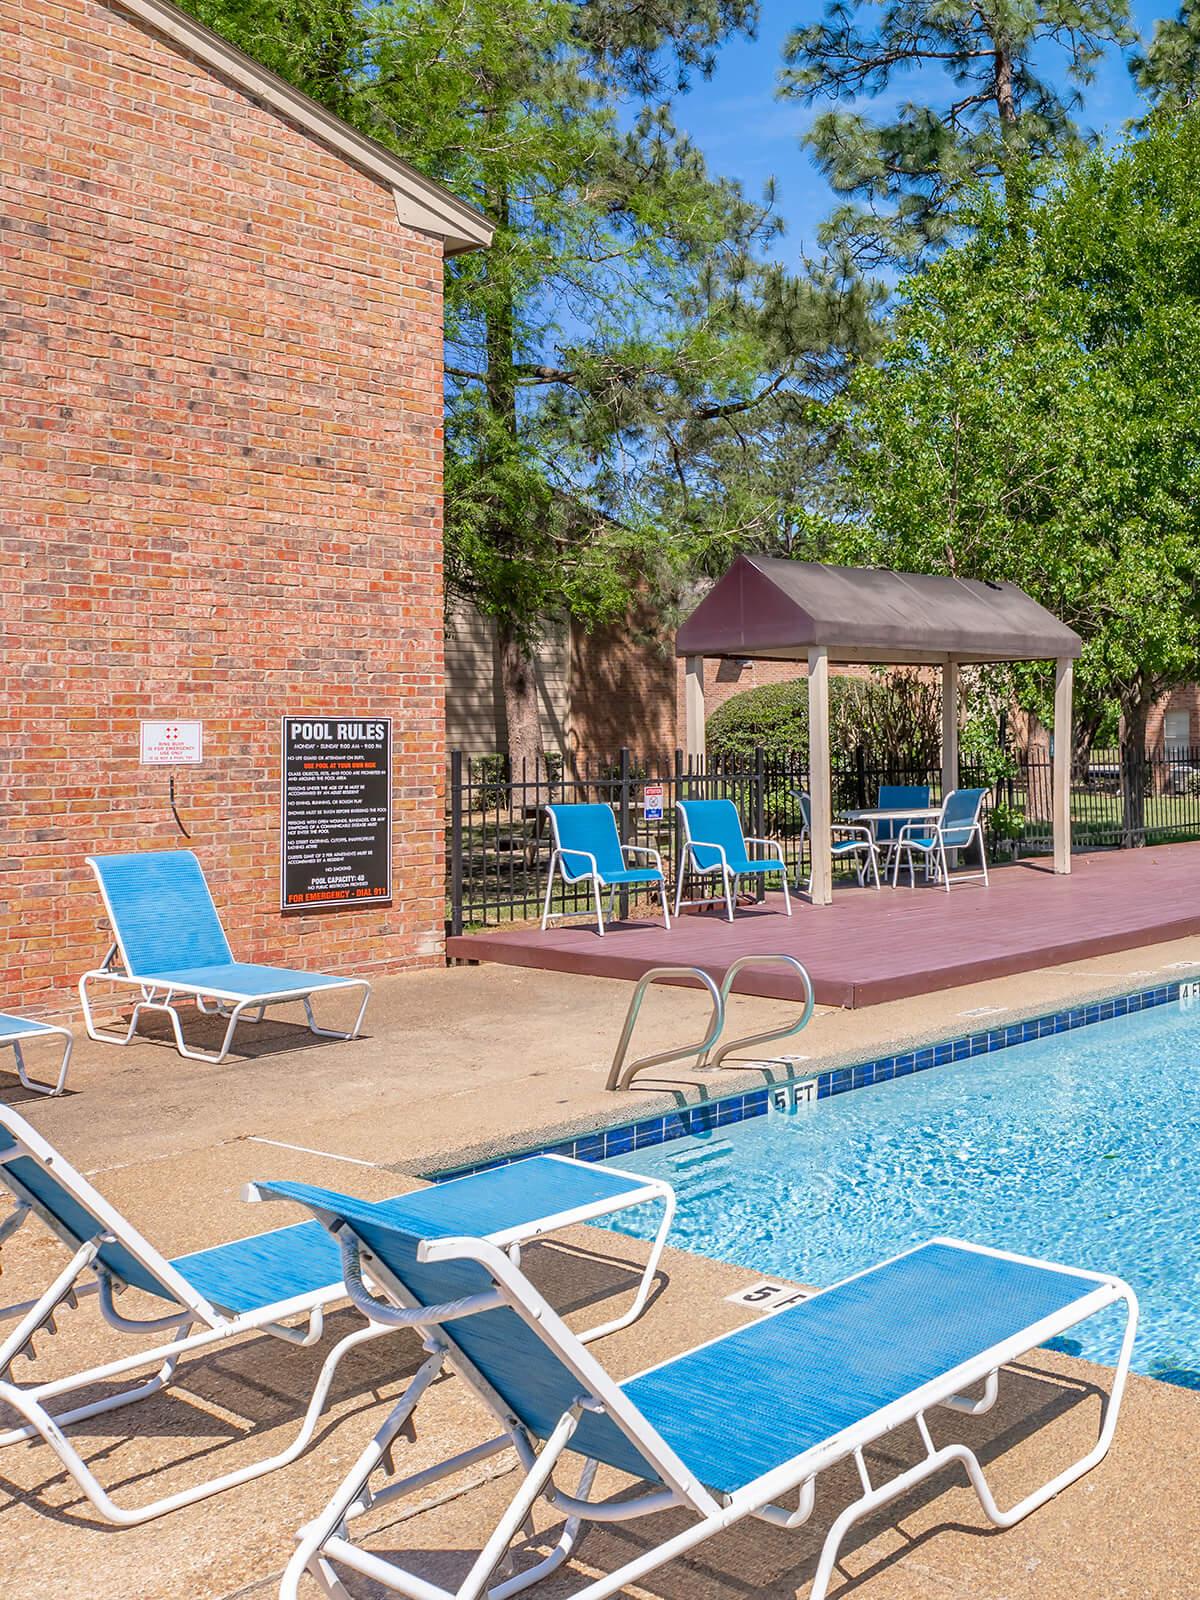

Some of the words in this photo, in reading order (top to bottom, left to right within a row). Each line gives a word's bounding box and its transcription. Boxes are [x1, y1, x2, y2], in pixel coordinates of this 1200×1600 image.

[291, 723, 333, 740] POOL
[337, 723, 385, 740] RULES
[327, 875, 356, 884] CAPACITY:
[288, 893, 304, 903] FOR
[305, 890, 350, 902] EMERGENCY
[356, 888, 371, 898] DIAL
[374, 887, 386, 897] 911
[1182, 985, 1188, 998] 4
[774, 1090, 786, 1110] 5
[794, 1084, 814, 1104] FT
[743, 1286, 781, 1301] 5
[772, 1294, 807, 1308] F
